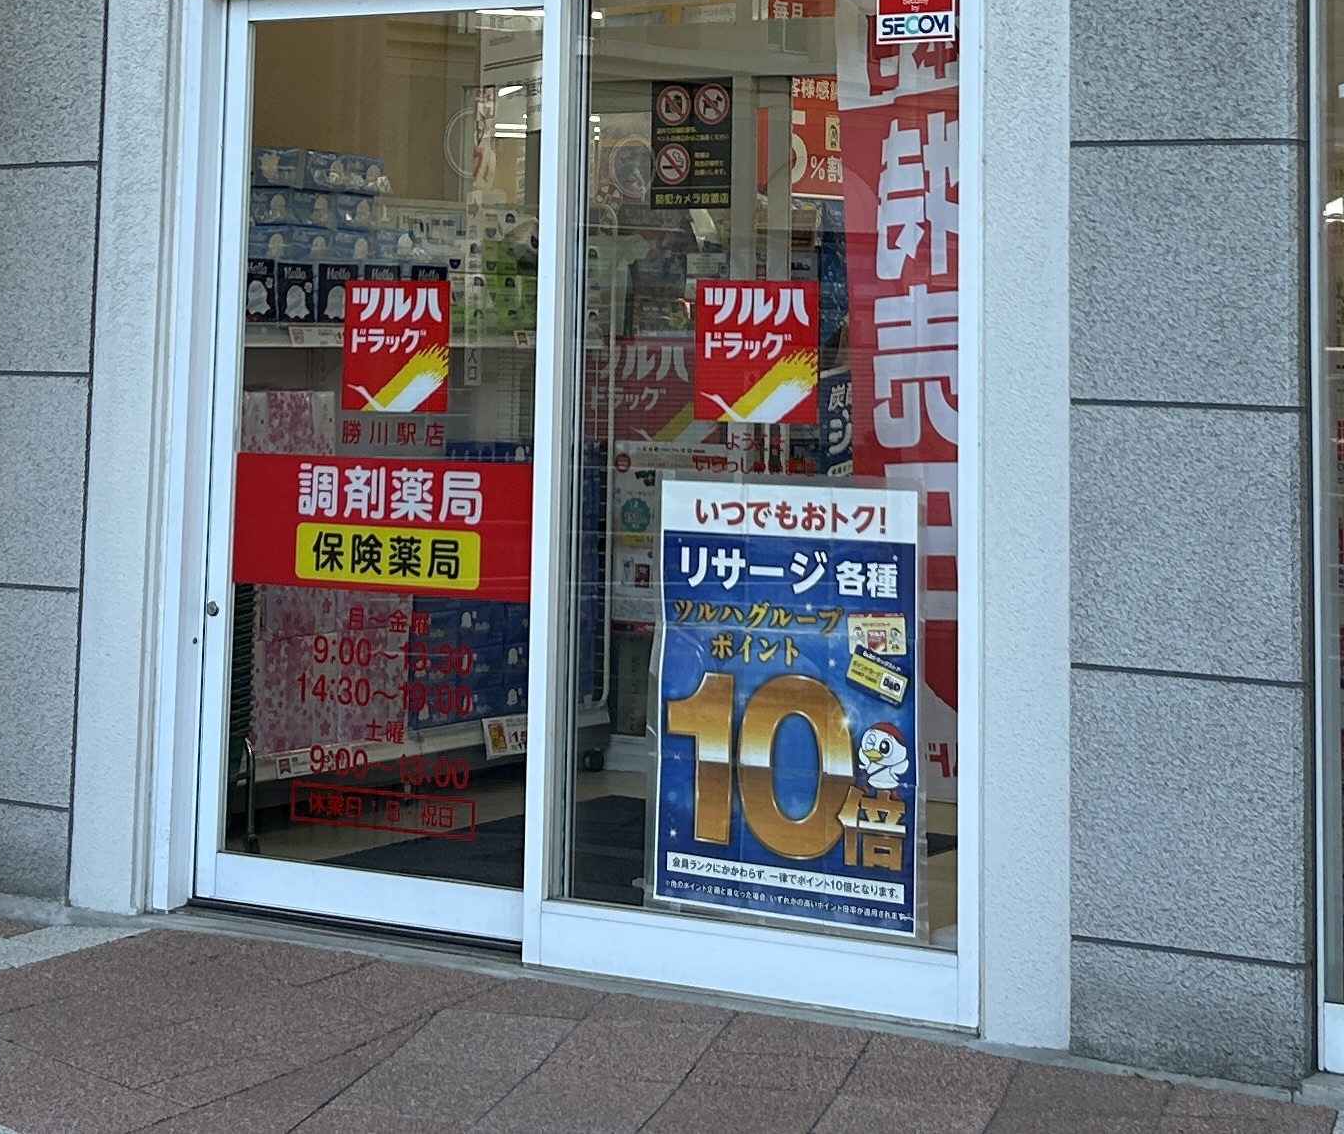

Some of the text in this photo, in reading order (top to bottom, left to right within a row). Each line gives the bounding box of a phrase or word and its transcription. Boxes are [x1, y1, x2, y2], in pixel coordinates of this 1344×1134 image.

[882, 15, 949, 36] SECOM
[351, 287, 443, 323] ツルハ
[704, 287, 809, 326] ツルハ
[351, 328, 427, 354] ドラッグ
[704, 333, 792, 361] ドラッグ
[342, 419, 445, 448] 勝川駅店
[297, 463, 484, 525] 調剤薬局
[695, 498, 888, 535] いつでもおトク!
[312, 532, 462, 581] 保険薬局
[680, 546, 899, 600] リサージ 各種
[674, 598, 844, 635] ツルハグループ
[710, 635, 800, 666] ポイント
[364, 719, 405, 744] 土曜
